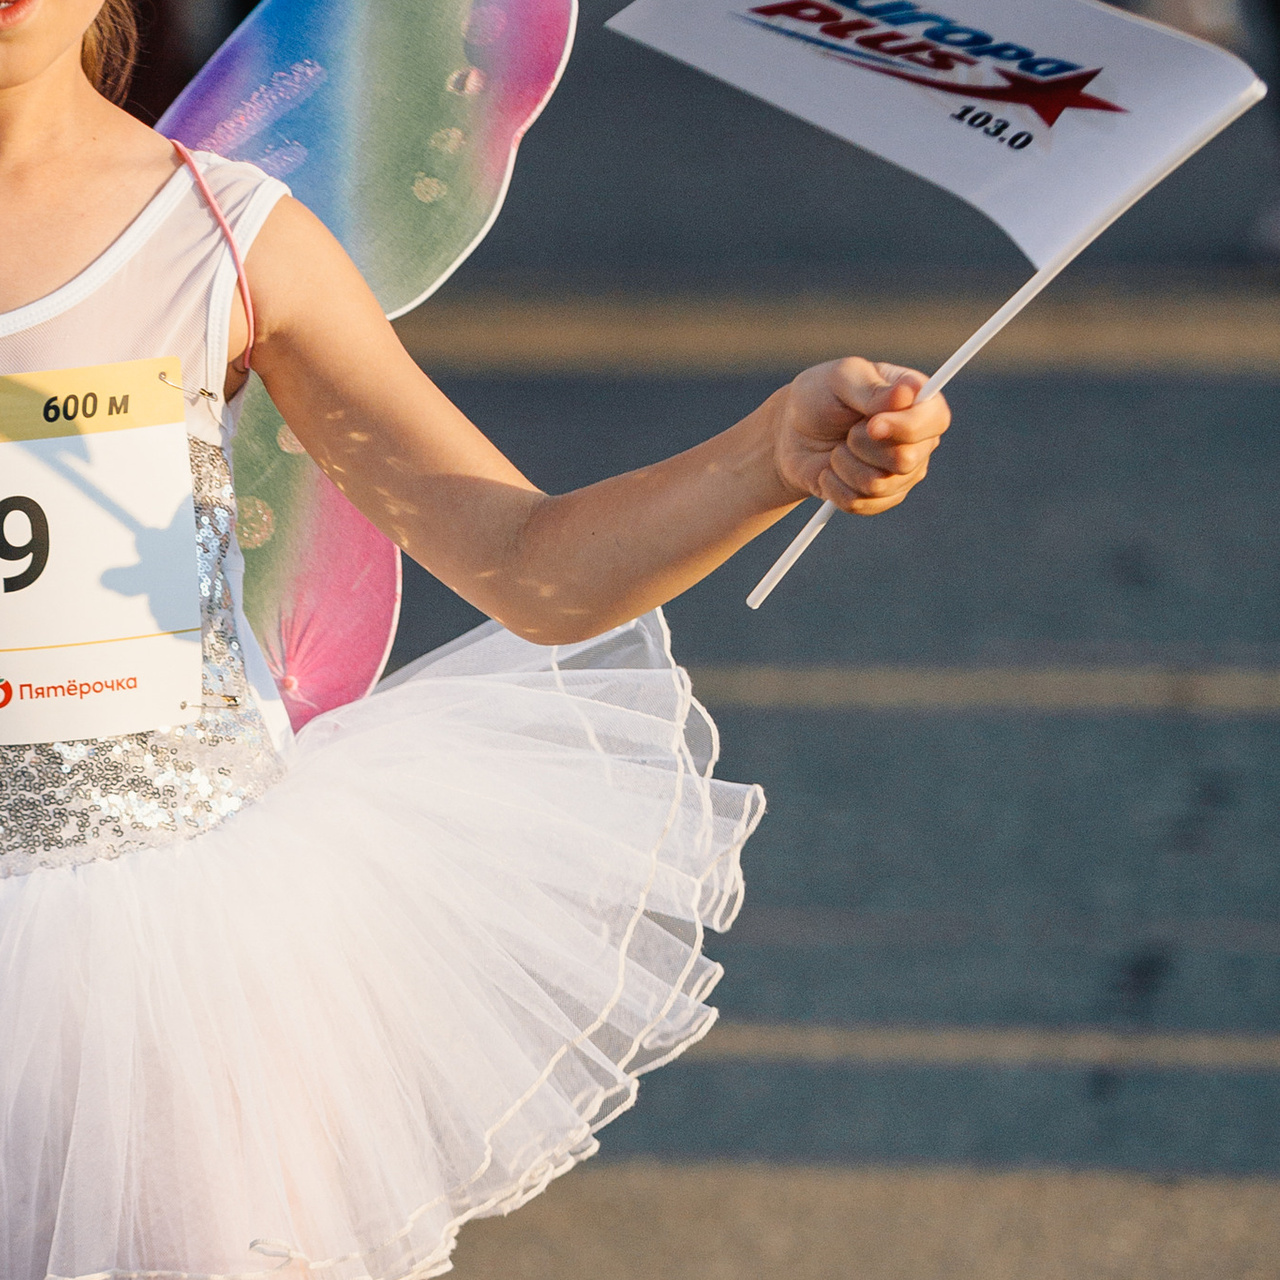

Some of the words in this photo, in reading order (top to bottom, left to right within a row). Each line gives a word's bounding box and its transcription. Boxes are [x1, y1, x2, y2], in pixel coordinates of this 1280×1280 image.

[949, 105, 1033, 150] 103.0
[43, 392, 98, 423] 600
[18, 676, 138, 700] Пятёрочка
